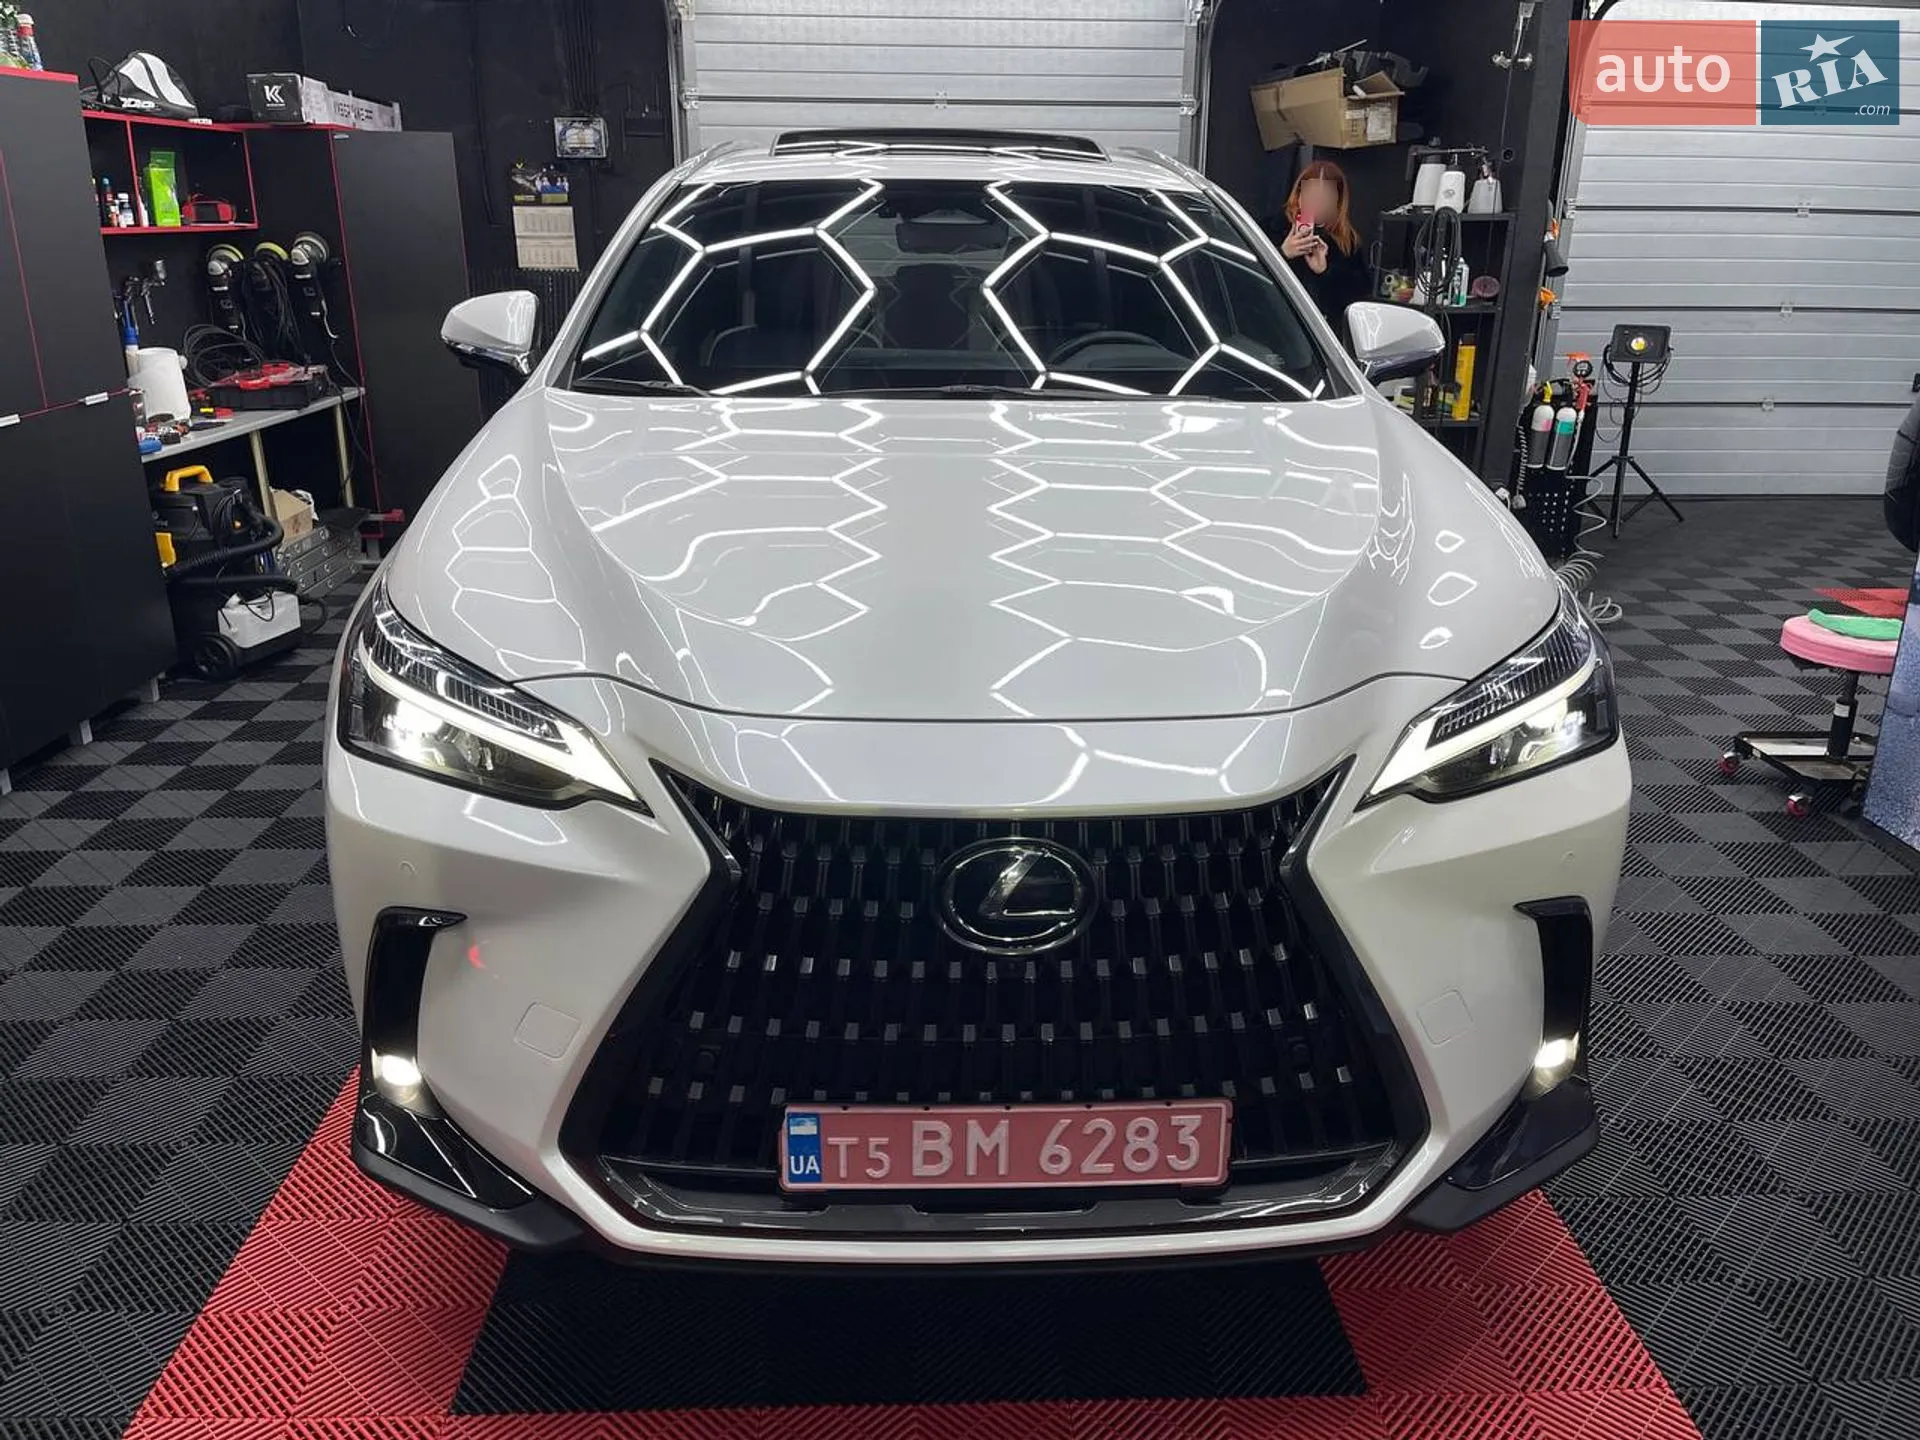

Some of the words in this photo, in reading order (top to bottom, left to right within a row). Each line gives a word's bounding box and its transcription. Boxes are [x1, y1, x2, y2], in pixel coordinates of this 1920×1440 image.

[790, 1155, 820, 1175] UA
[827, 1136, 891, 1179] T5
[912, 1119, 1010, 1177] BM
[1039, 1114, 1202, 1176] 6283
